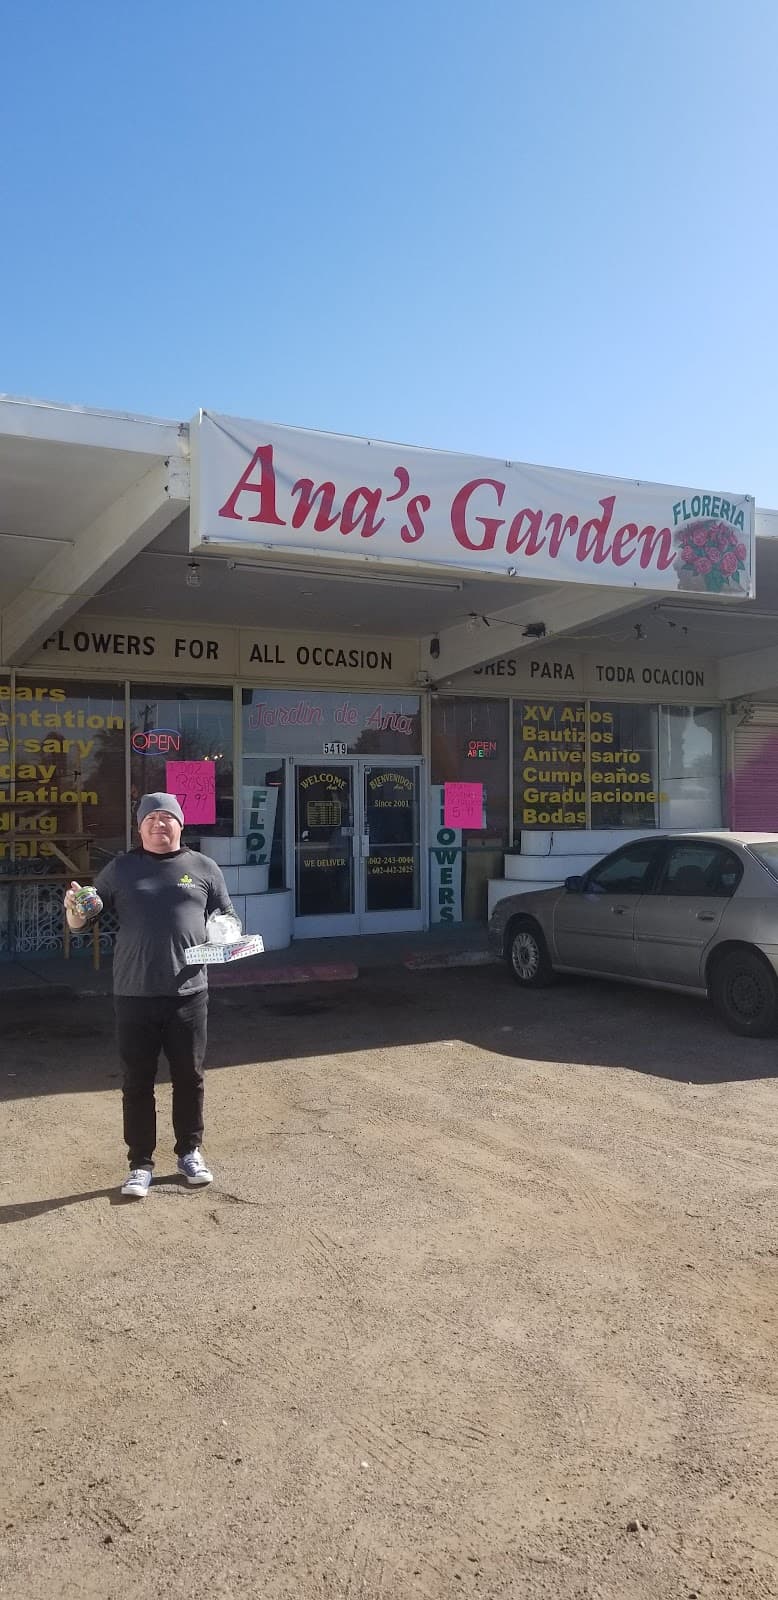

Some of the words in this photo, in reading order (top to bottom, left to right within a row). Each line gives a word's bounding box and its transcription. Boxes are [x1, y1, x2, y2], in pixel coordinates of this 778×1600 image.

[218, 444, 431, 543] Ana's
[451, 478, 676, 569] Garden
[673, 495, 745, 531] FLORERIA
[174, 638, 220, 661] FOR
[249, 643, 286, 665] ALL
[296, 645, 393, 670] OCCASION
[530, 661, 575, 680] PARA
[596, 664, 636, 684] TODA
[642, 667, 705, 687] OCACION
[335, 703, 359, 725] de
[367, 703, 413, 735] Ana
[523, 705, 554, 721] XV
[560, 706, 614, 724] Años
[132, 732, 181, 752] OPEN
[523, 725, 614, 744] Bautizos
[323, 743, 347, 754] 5419
[468, 740, 497, 751] OPEN
[523, 746, 641, 763] Aniversario
[300, 773, 347, 790] WELCOME
[369, 773, 415, 791] BIENVENIDOS
[523, 767, 651, 786] Cumpleaños
[374, 799, 393, 808] Since
[393, 799, 409, 808] 2001
[523, 788, 669, 804] Graduaciones
[523, 808, 587, 824] Bodas
[304, 859, 315, 868] WE
[317, 858, 346, 868] DELIVER
